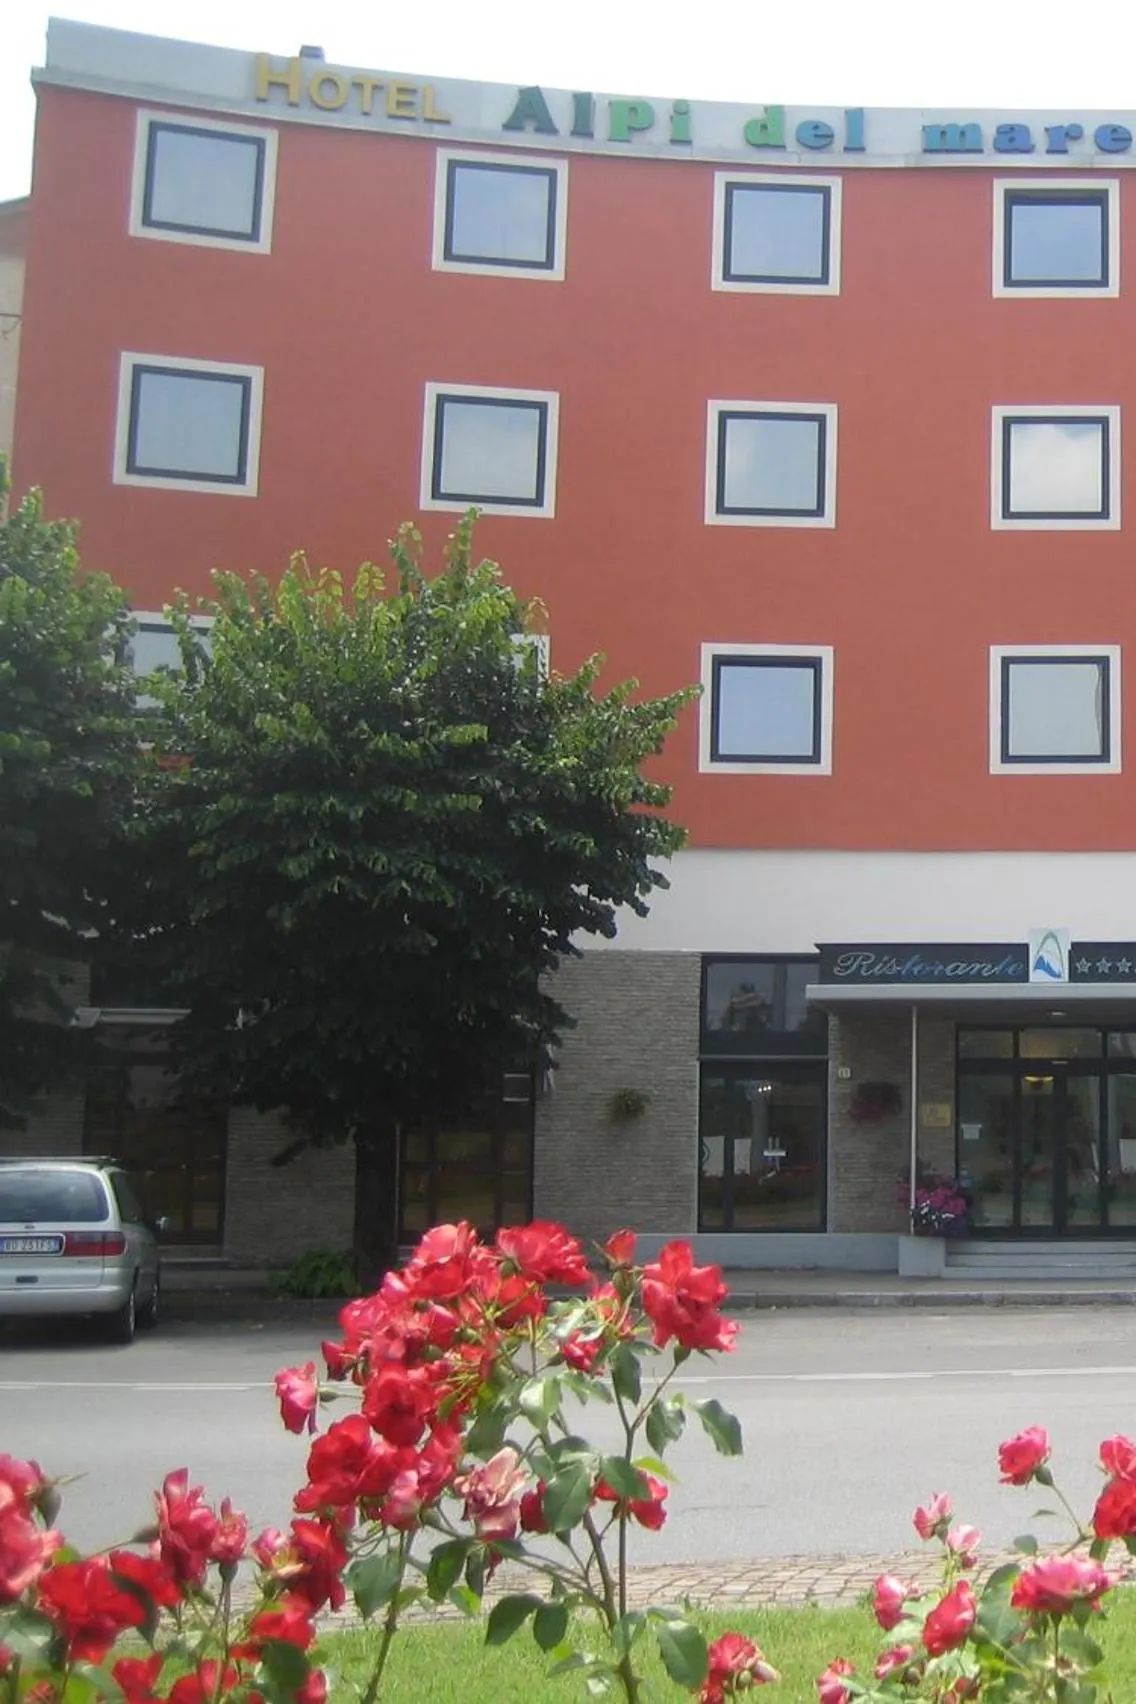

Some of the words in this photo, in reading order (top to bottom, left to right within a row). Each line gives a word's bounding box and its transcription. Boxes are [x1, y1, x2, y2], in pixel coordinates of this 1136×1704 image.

[254, 53, 451, 125] HOTEL
[502, 85, 693, 143] Alpi
[744, 104, 866, 152] del
[922, 121, 1133, 153] mare
[833, 951, 1024, 977] Ristorante
